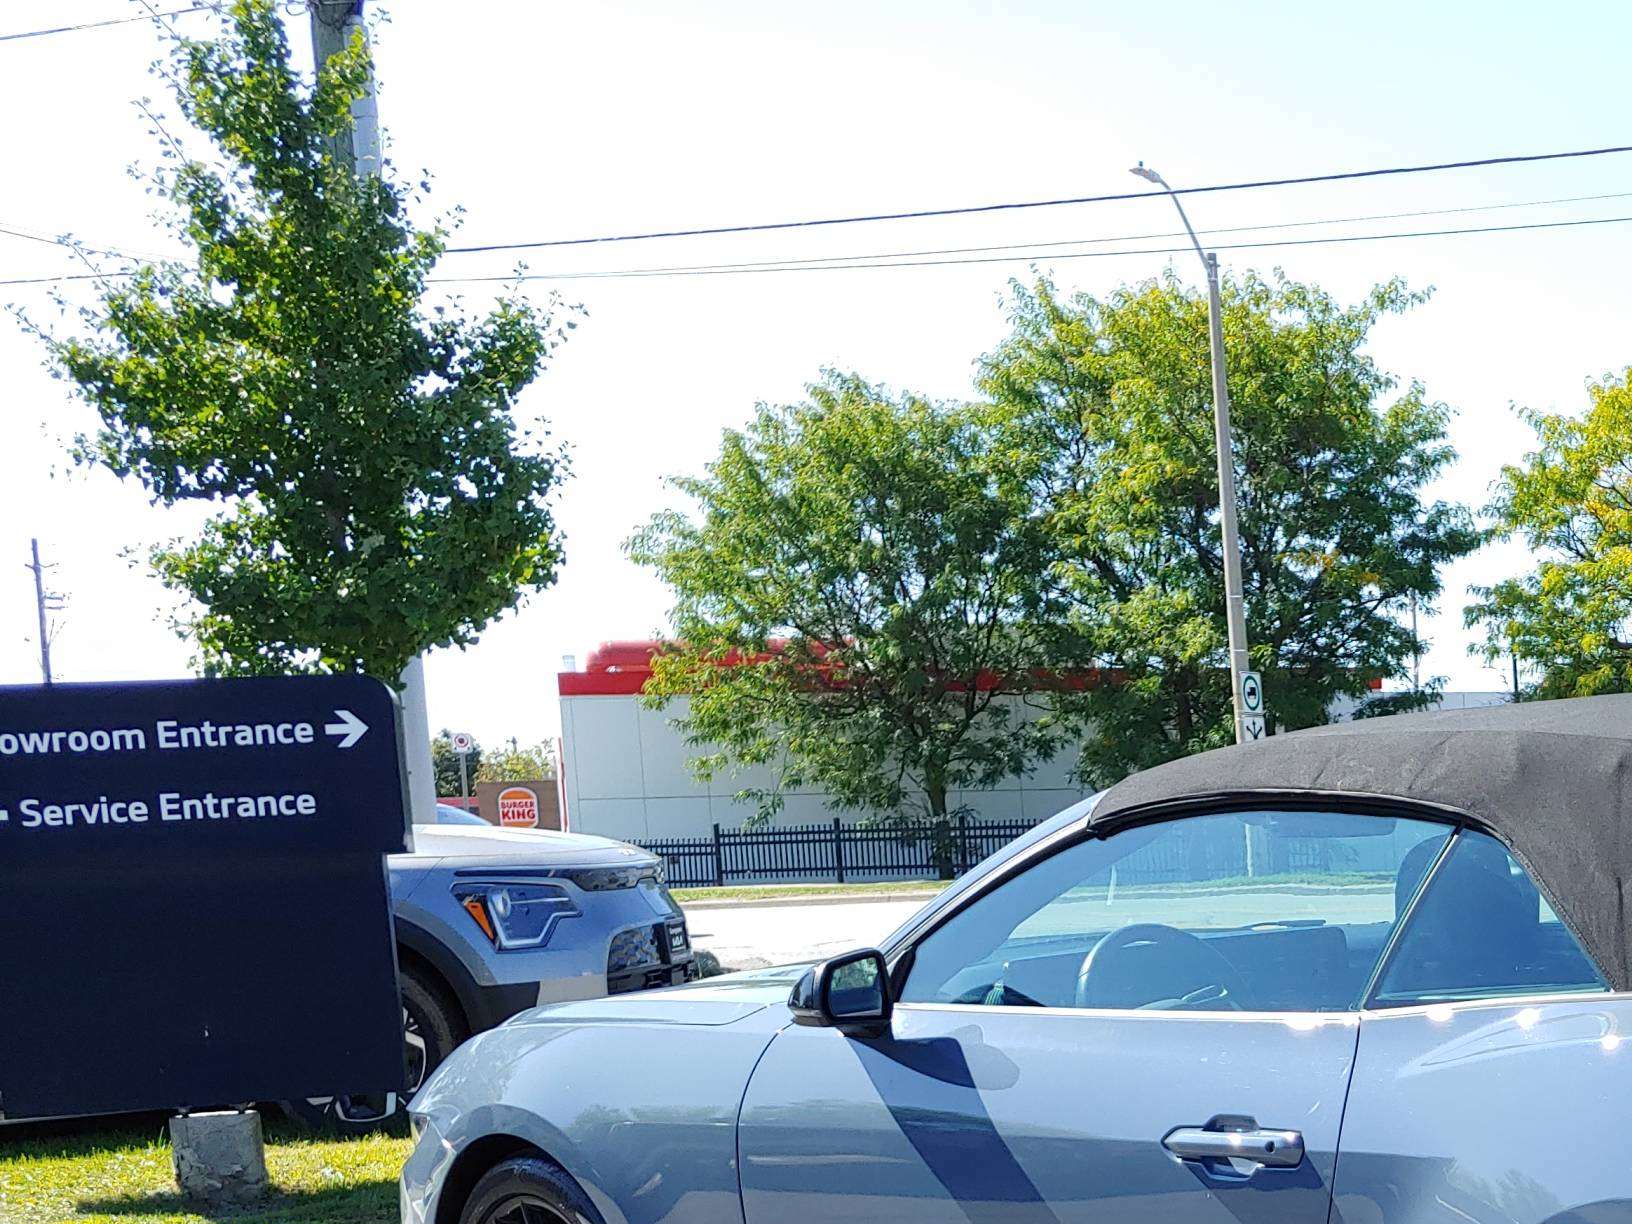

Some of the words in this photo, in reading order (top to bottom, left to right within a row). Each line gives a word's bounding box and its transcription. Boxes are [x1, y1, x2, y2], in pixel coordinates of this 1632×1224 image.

[156, 720, 314, 748] Entrance
[19, 796, 149, 827] Service
[159, 793, 316, 821] Entrance
[500, 800, 534, 809] BURGER
[501, 809, 536, 820] KING
